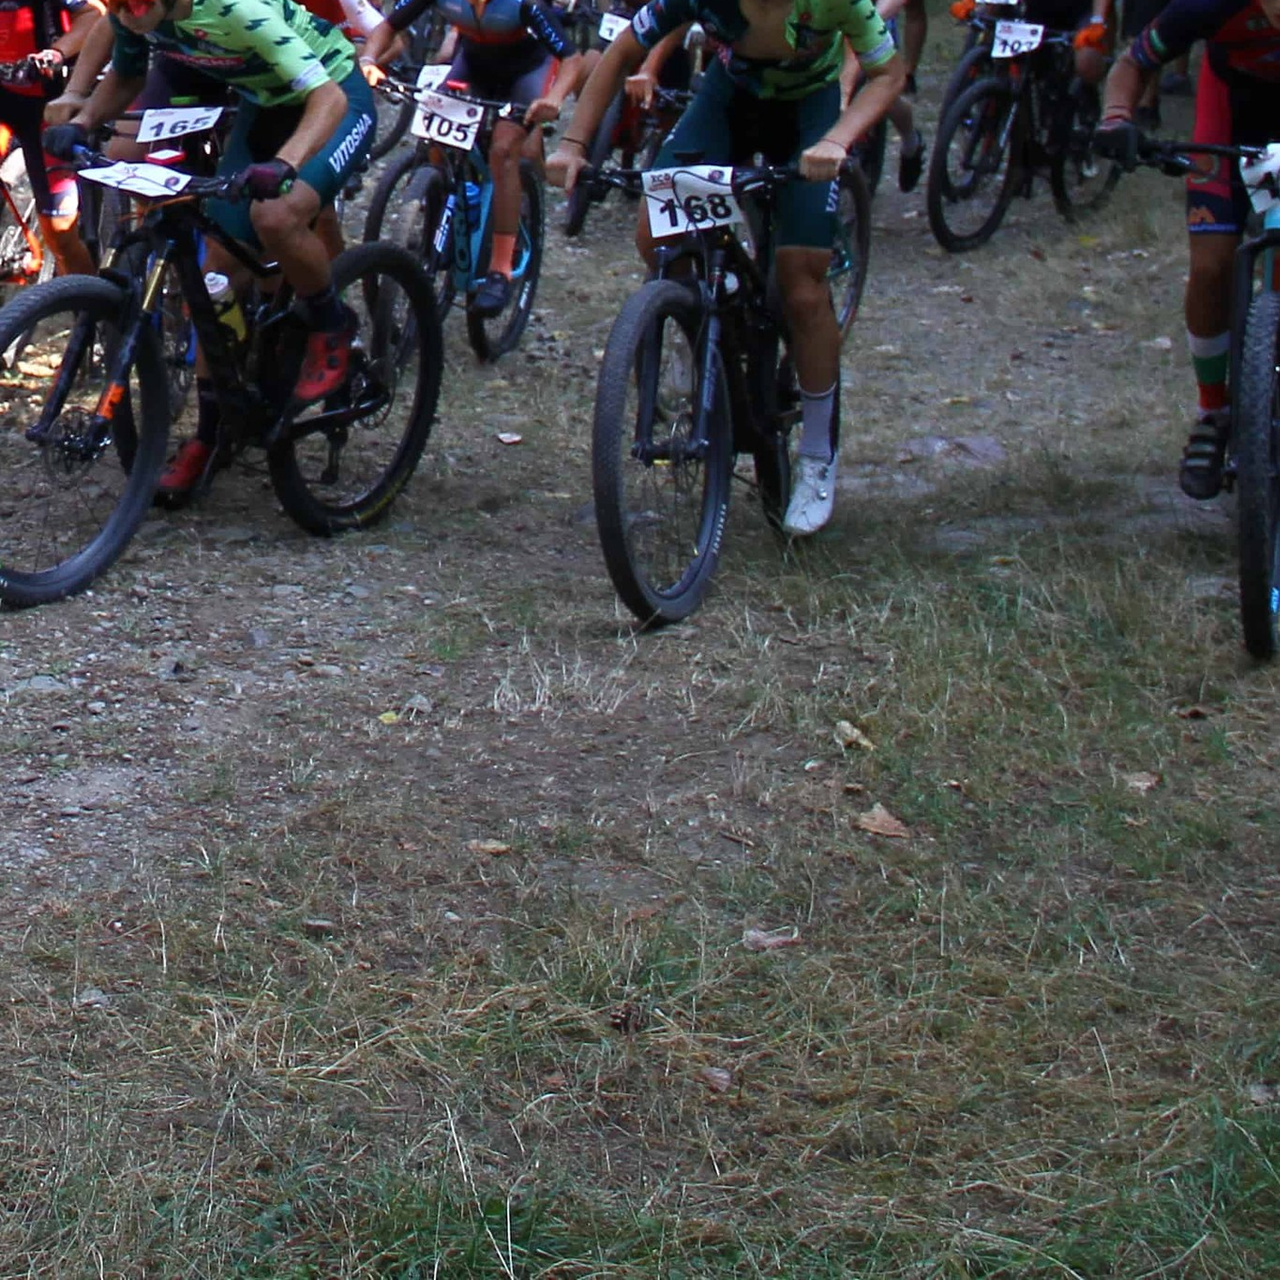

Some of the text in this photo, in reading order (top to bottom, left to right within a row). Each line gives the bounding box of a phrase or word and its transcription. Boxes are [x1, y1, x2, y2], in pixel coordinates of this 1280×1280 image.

[149, 116, 212, 138] 165
[423, 113, 468, 142] 105
[328, 113, 373, 173] VITOSHA
[659, 193, 732, 227] 168
